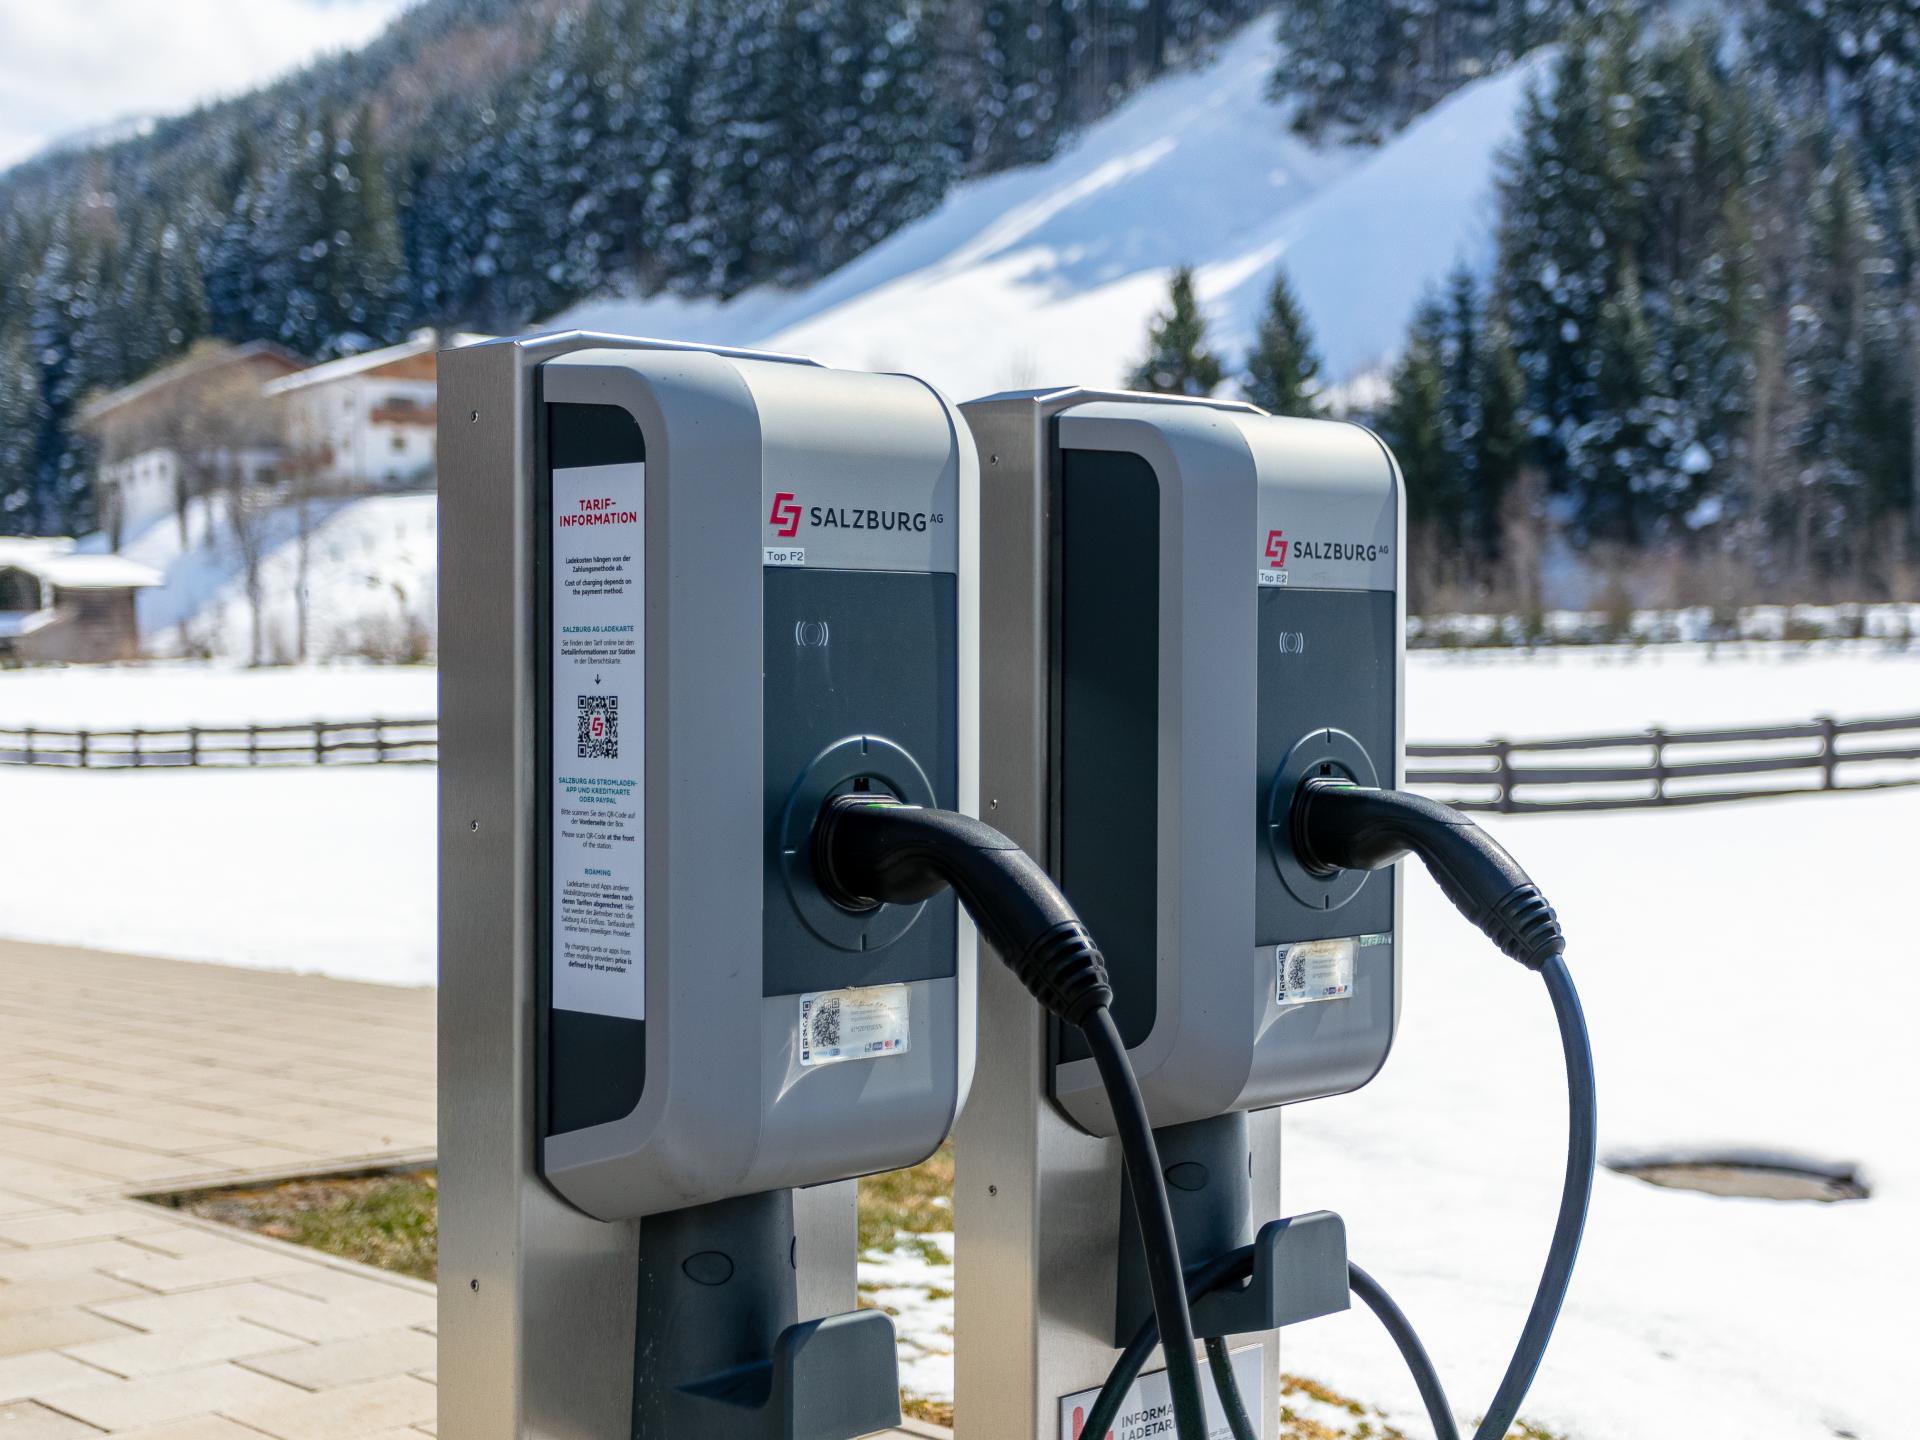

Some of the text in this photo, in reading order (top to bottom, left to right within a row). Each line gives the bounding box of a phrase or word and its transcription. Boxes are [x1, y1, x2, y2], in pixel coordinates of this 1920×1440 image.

[579, 498, 616, 511] TARIF-
[560, 512, 637, 527] INFORMATION
[810, 507, 944, 532] SALZBURG AG
[767, 551, 803, 562] Top F2
[1294, 542, 1389, 561] SALZBURG AG
[573, 565, 615, 573] Zahlungsmethode
[582, 579, 602, 587] charging
[1260, 573, 1287, 582] Top E2
[582, 588, 602, 596] payment
[1121, 1404, 1175, 1428] INFORMA
